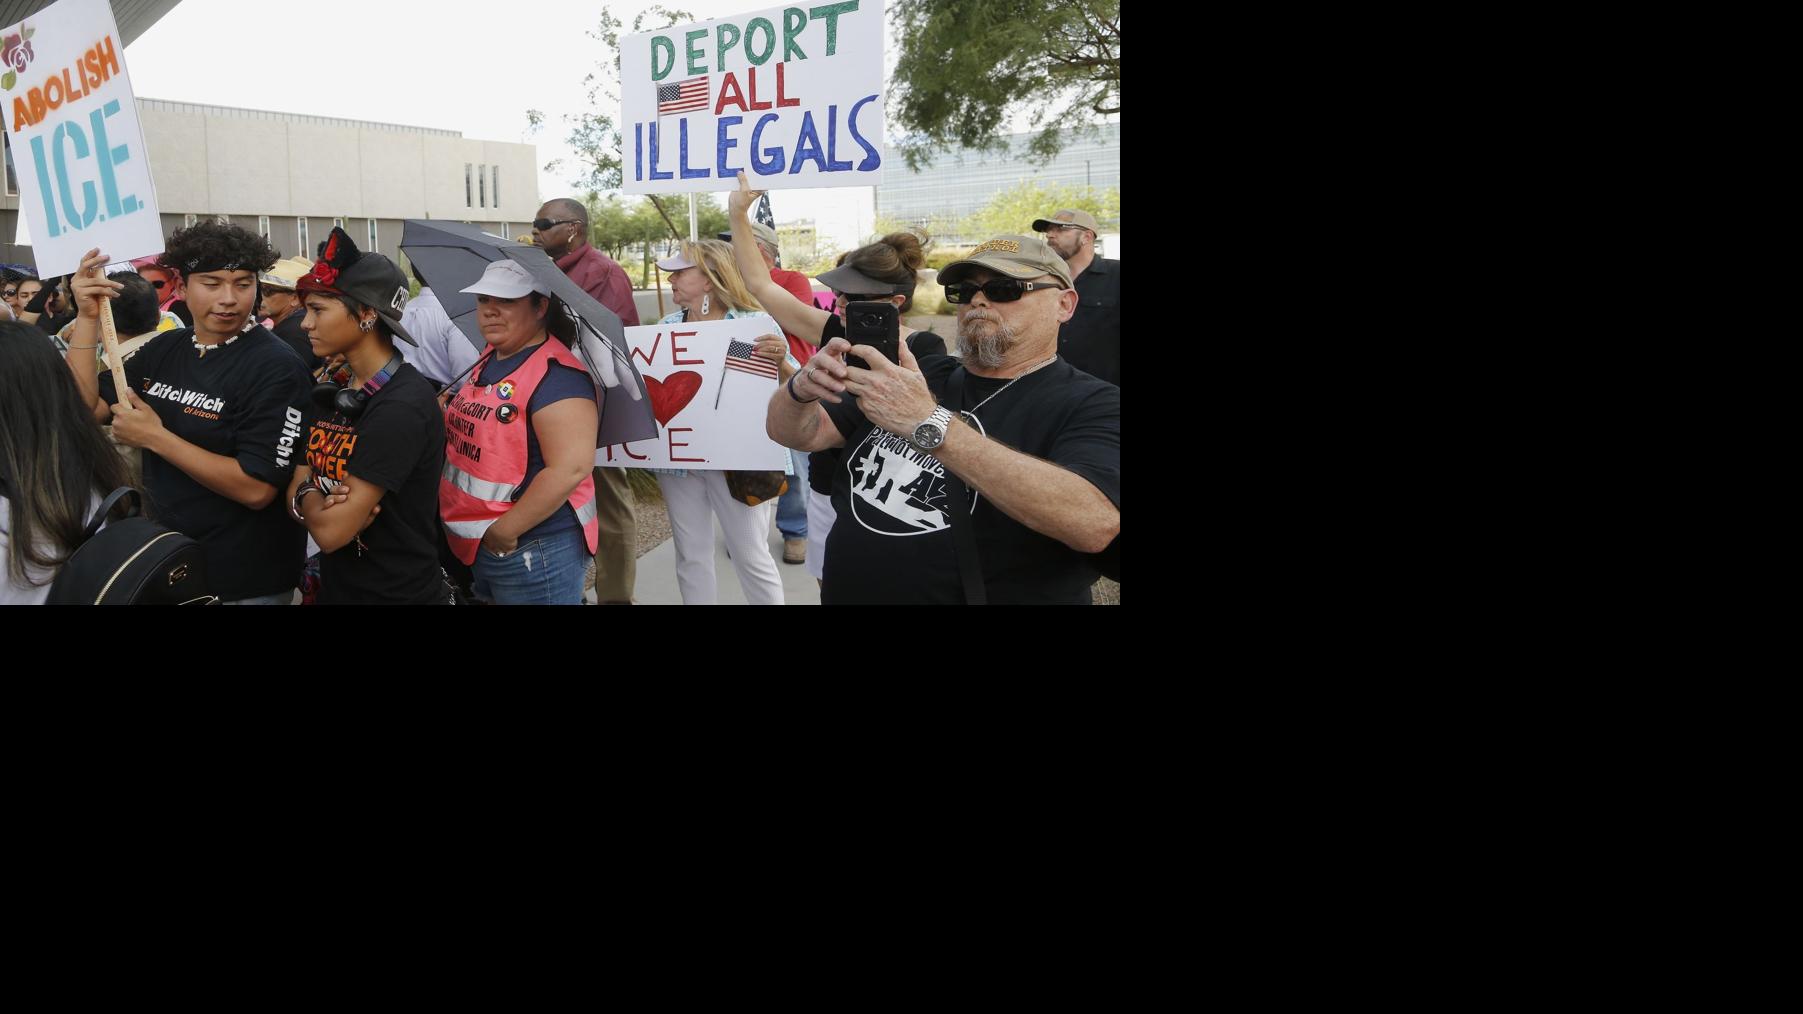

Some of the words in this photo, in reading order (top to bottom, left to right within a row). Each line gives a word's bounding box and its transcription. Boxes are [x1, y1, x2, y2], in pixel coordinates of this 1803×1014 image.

[650, 0, 859, 81] DEPORT
[13, 35, 120, 132] ABOLISH
[714, 61, 800, 115] ALL
[635, 94, 881, 181] ILLEGALS
[30, 99, 144, 237] I.C.E.
[630, 331, 705, 366] WE
[180, 390, 226, 413] Witch
[276, 406, 302, 458] Ditch
[308, 426, 358, 456] OUTH
[862, 426, 911, 459] Patriot
